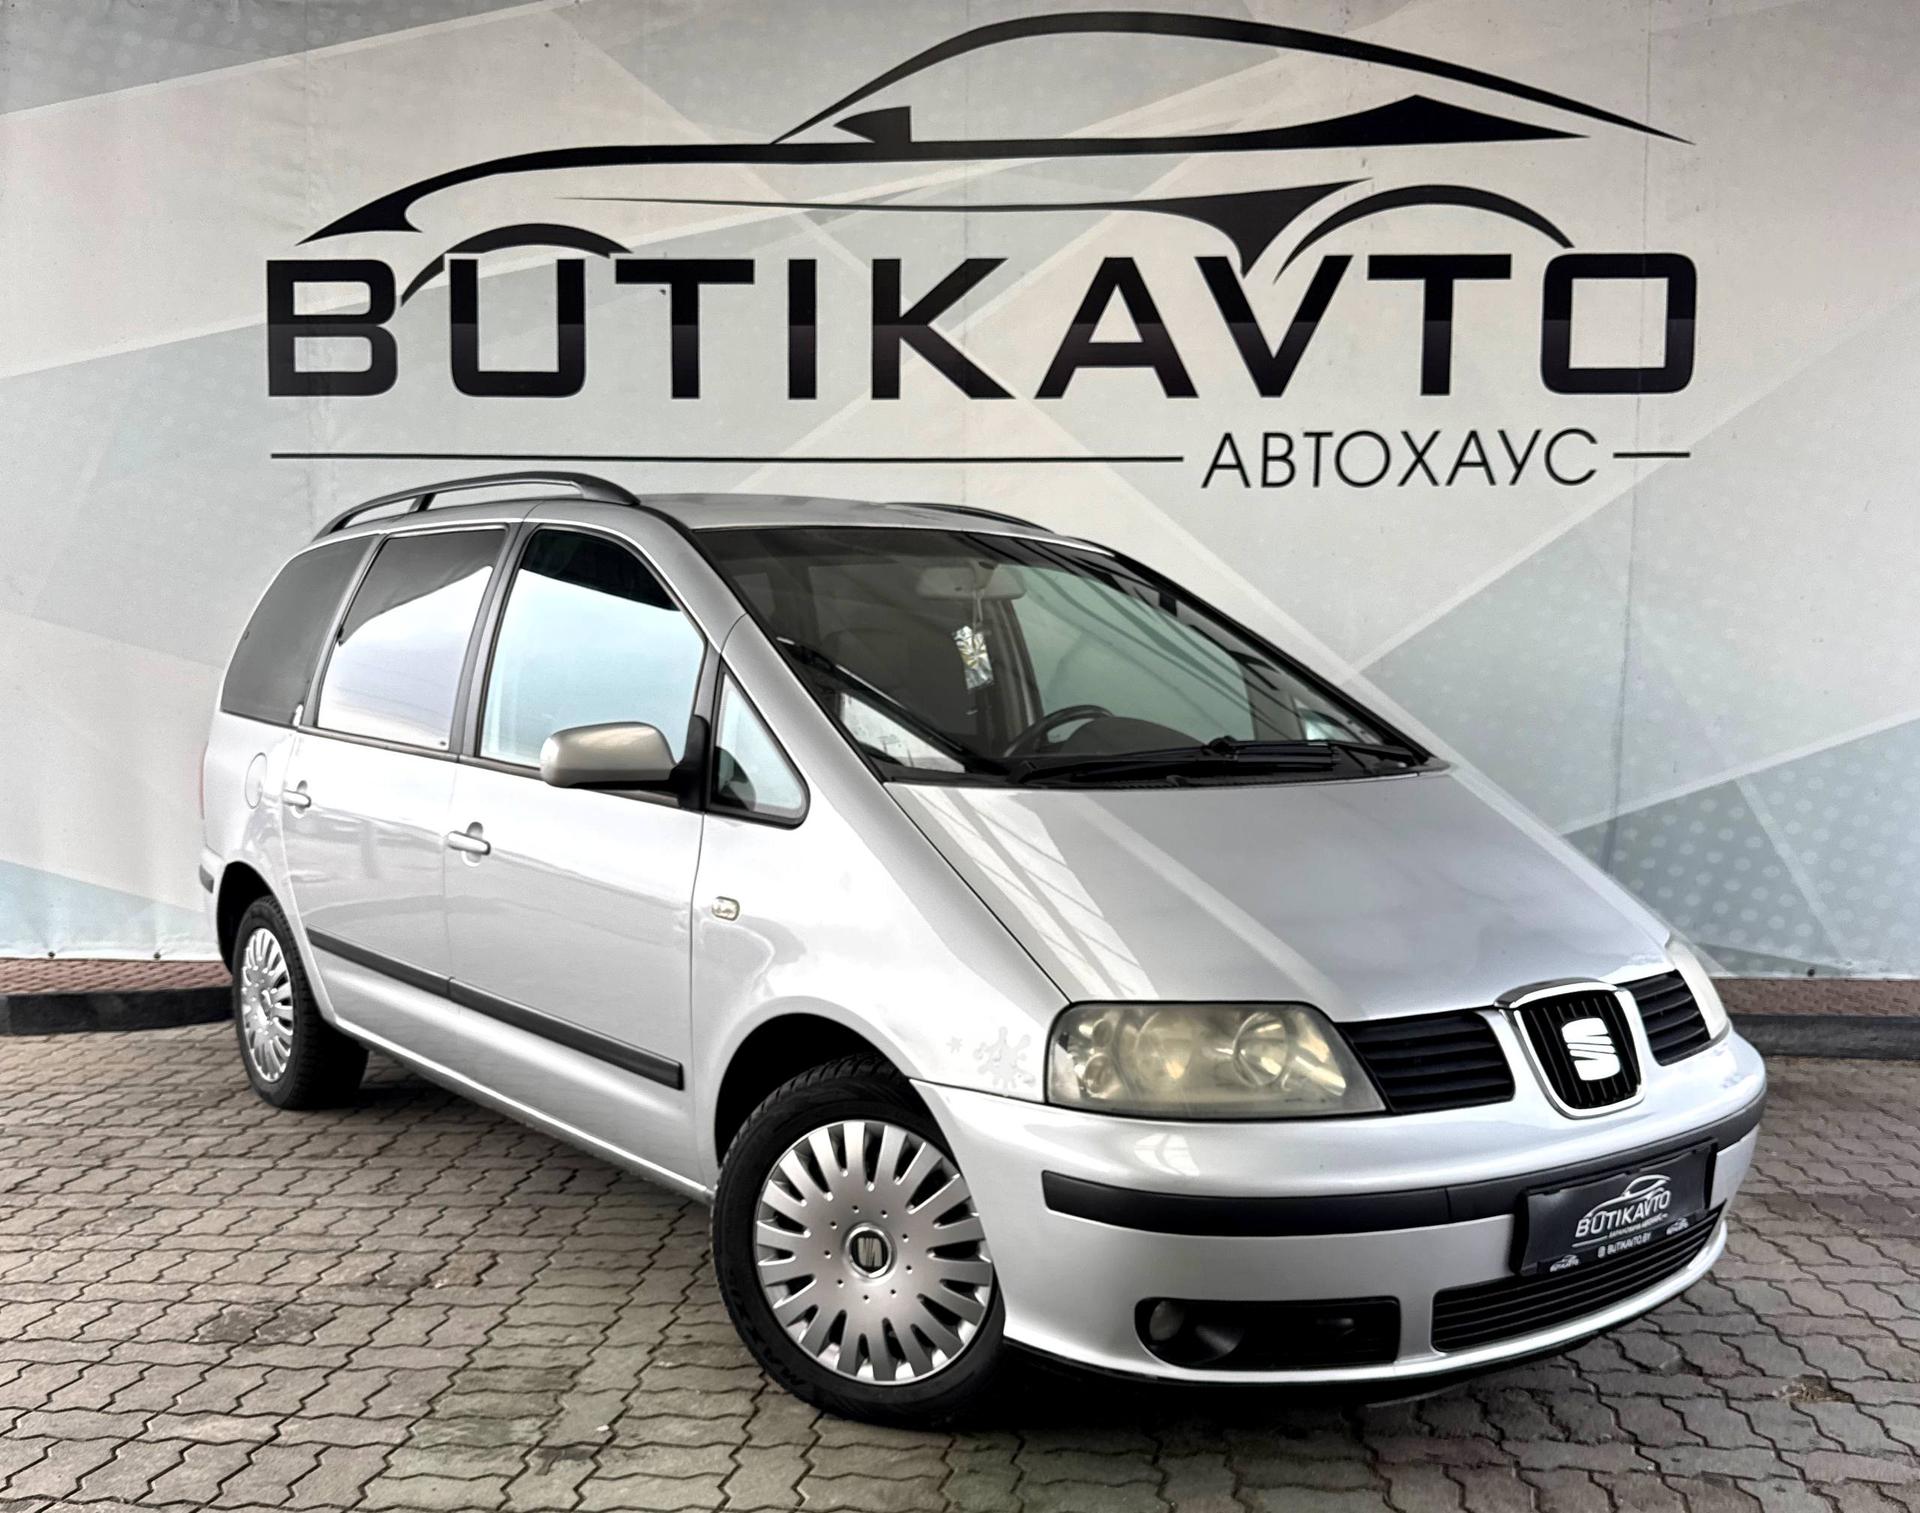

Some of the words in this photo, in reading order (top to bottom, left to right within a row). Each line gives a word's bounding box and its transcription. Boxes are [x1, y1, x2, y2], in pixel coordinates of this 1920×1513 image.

[266, 253, 1697, 400] BUTIKAVTO
[1201, 427, 1599, 489] АВТОХАУС
[1575, 1190, 1671, 1238] BUTIKAVTO
